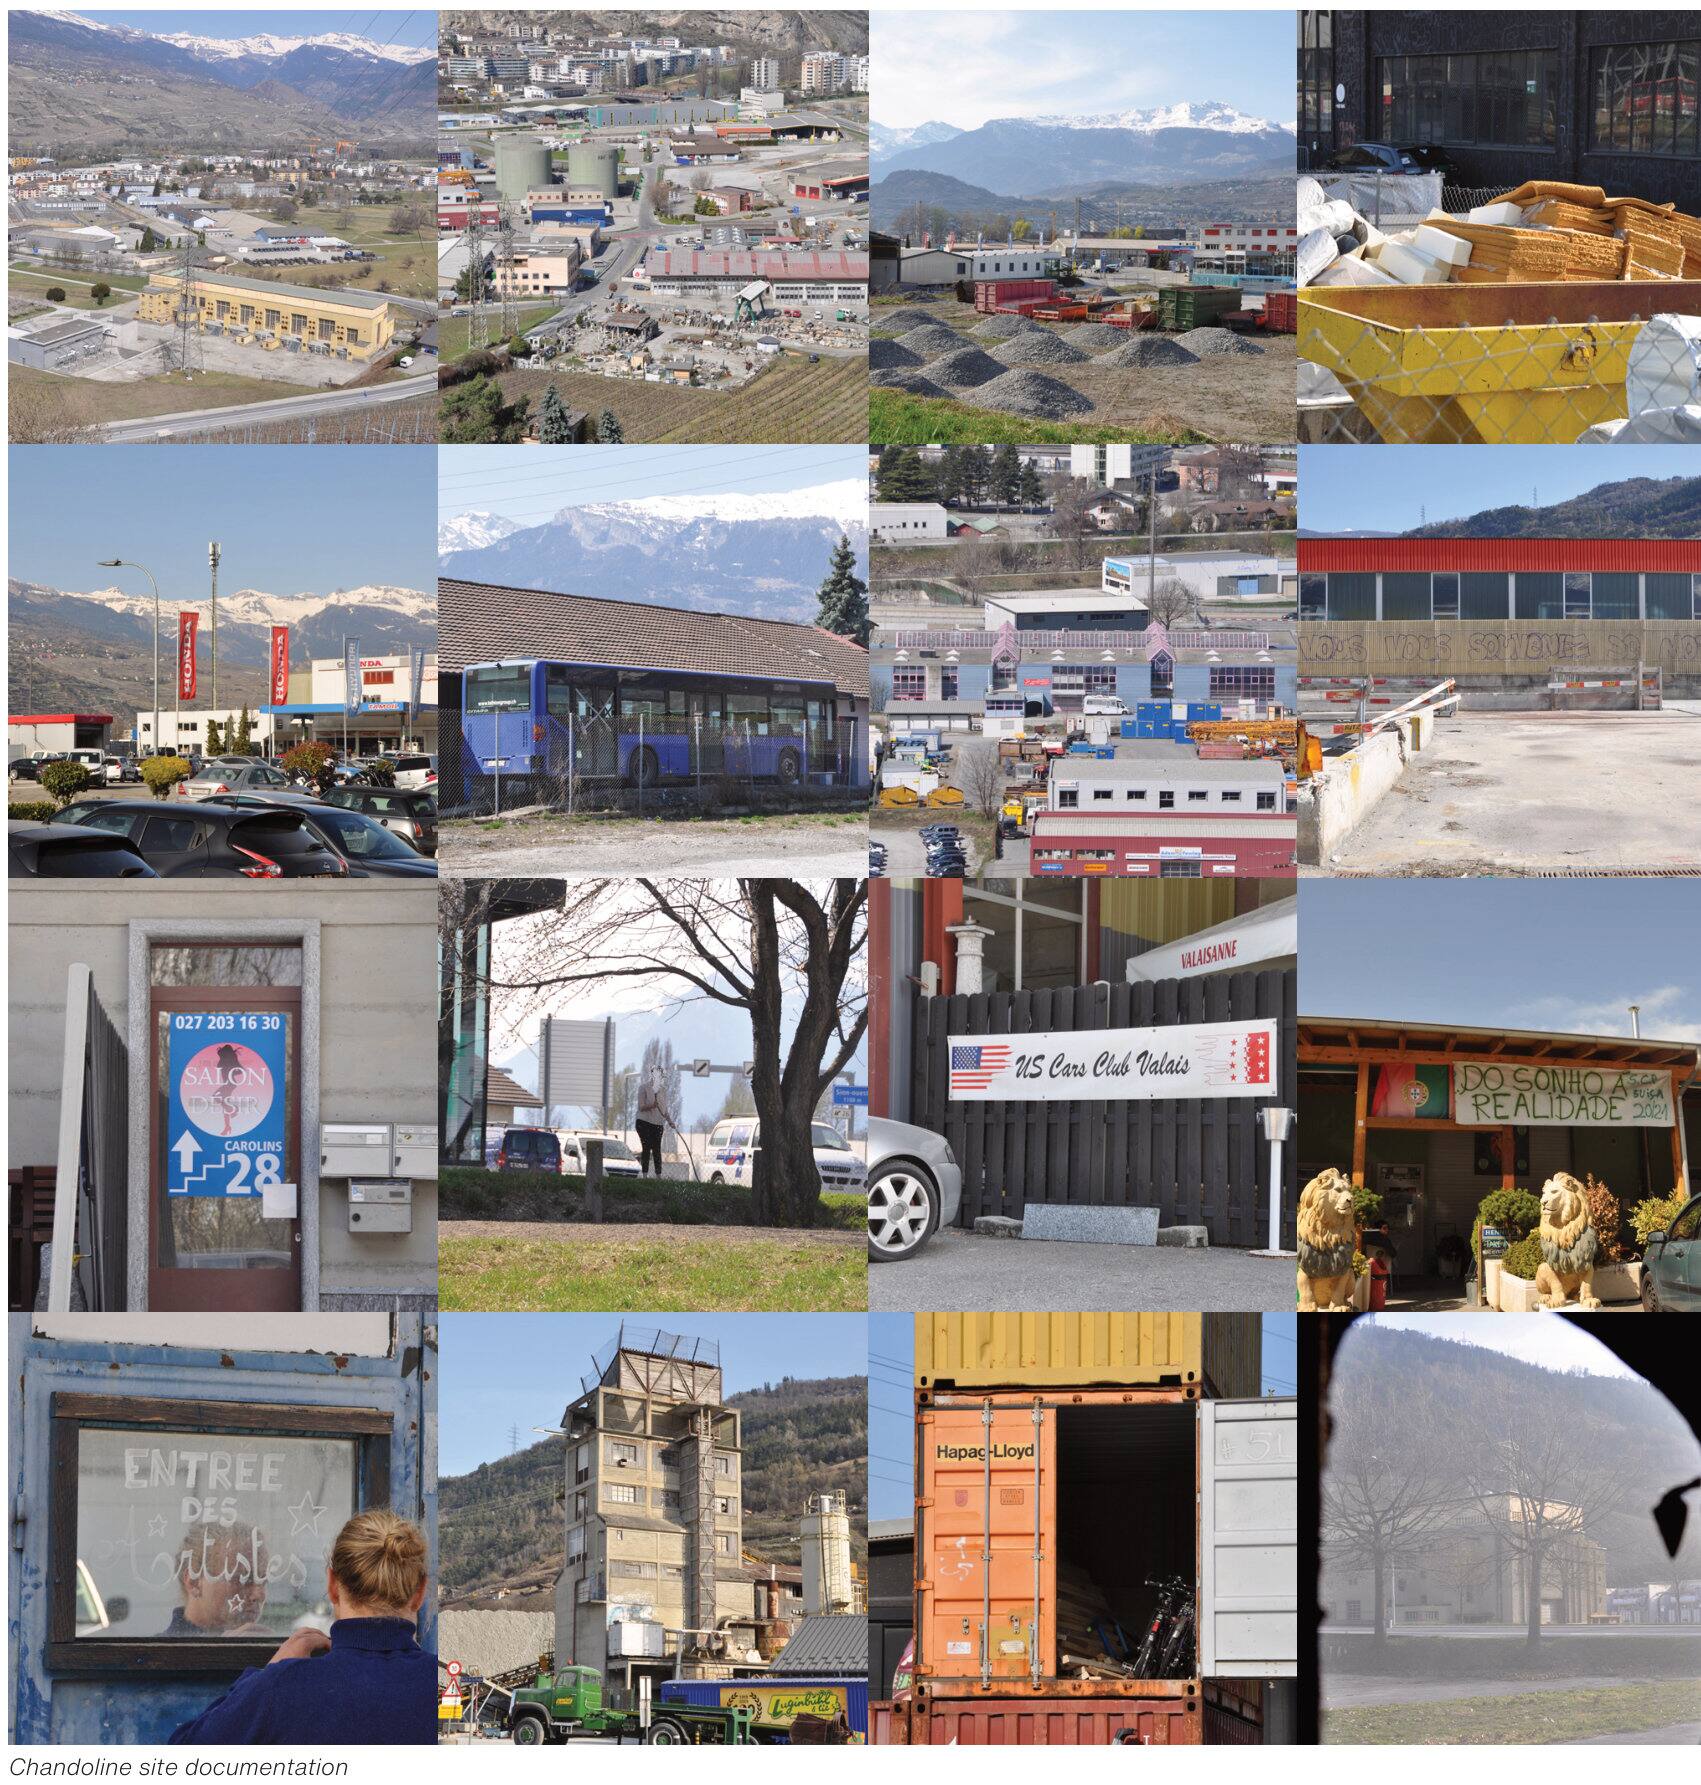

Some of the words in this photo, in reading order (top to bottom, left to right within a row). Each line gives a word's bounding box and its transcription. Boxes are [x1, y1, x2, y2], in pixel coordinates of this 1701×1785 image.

[183, 620, 193, 693] HONDA
[276, 634, 285, 701] HONDA
[1180, 940, 1238, 969] VALAISANNE
[175, 1016, 203, 1030] 027
[207, 1016, 235, 1030] 203
[240, 1016, 257, 1030] 16
[262, 1016, 280, 1030] 30
[184, 1066, 267, 1086] SALON
[1015, 1054, 1046, 1079] US
[1049, 1052, 1088, 1078] Cars
[1092, 1050, 1132, 1078] Club
[1136, 1049, 1192, 1076] Valais
[1461, 1065, 1504, 1095] DO
[1513, 1068, 1603, 1095] SONHO
[191, 1091, 261, 1115] DÉSIR
[224, 1141, 283, 1152] CAROLINS
[226, 1152, 282, 1195] 28
[180, 1496, 238, 1527] DES
